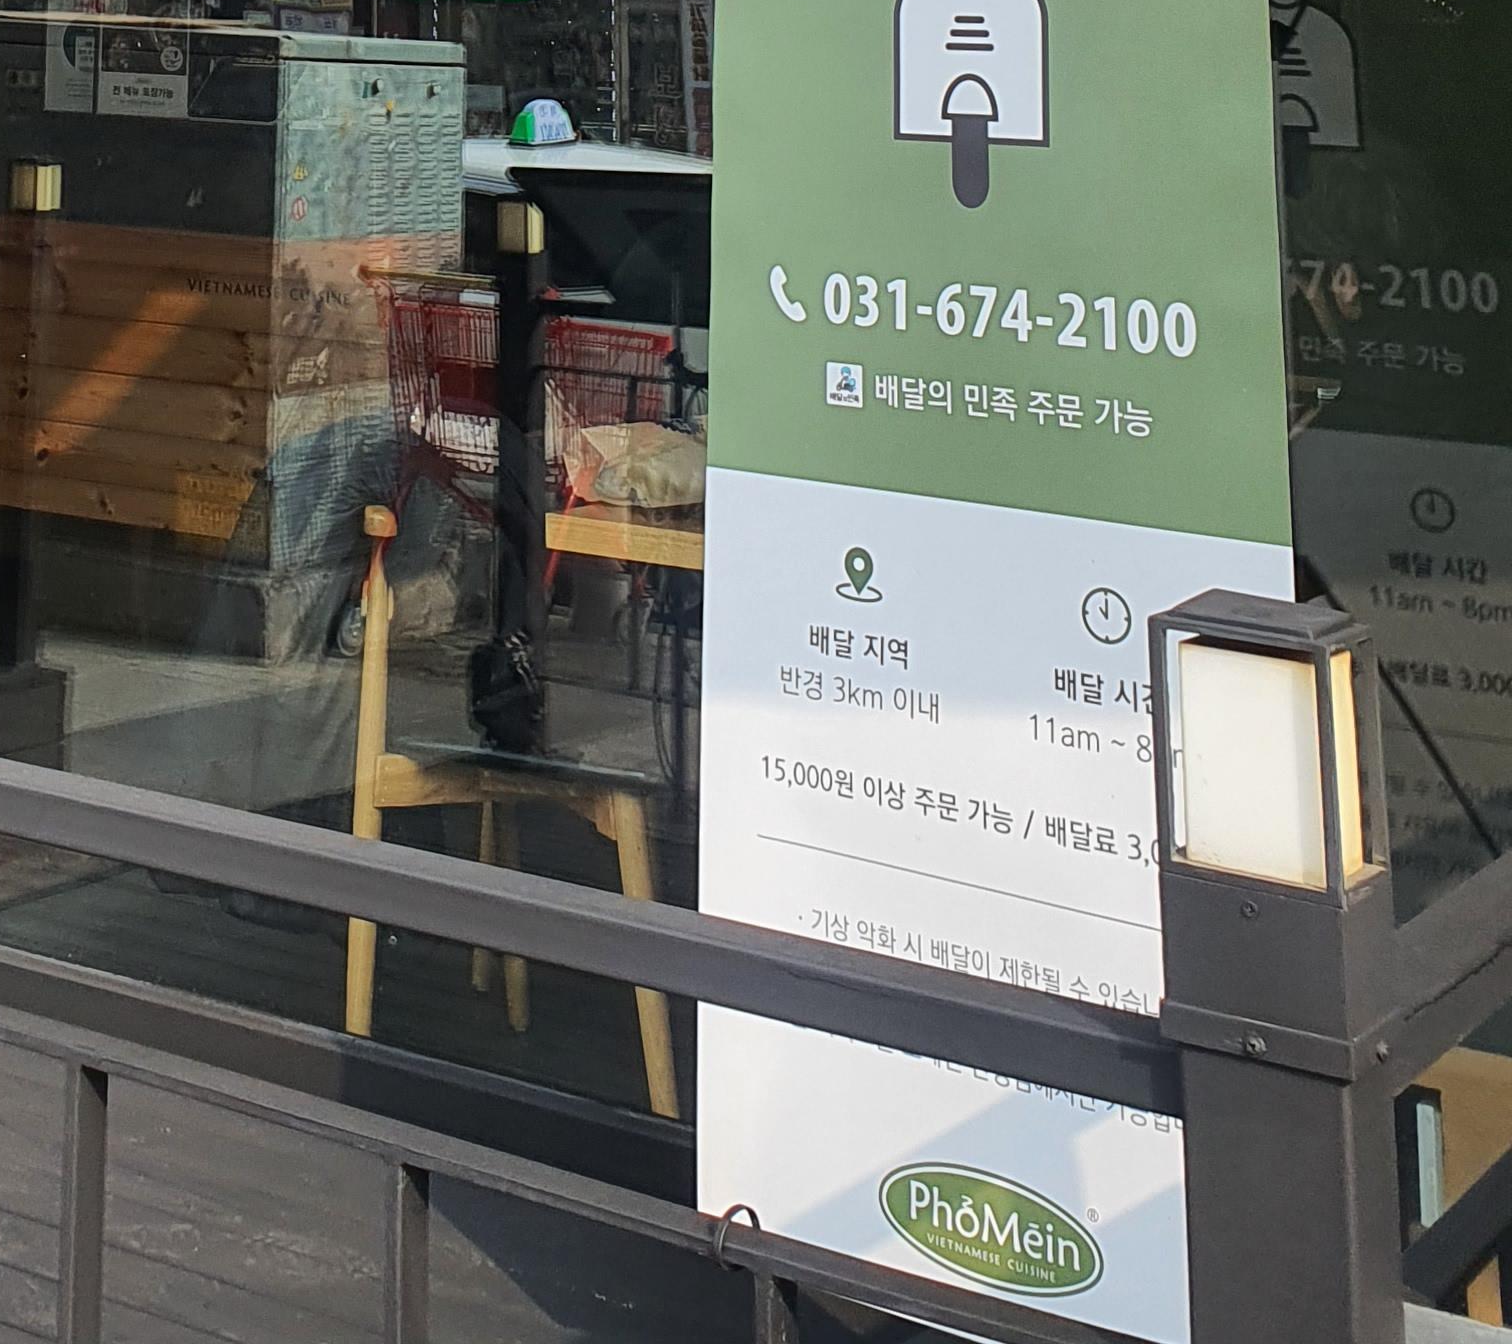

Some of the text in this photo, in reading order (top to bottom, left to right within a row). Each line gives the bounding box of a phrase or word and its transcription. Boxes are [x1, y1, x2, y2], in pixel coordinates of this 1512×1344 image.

[823, 271, 1198, 358] 031-674-2100
[874, 374, 1154, 438] 배달의 민족 주문 가능
[808, 624, 909, 670] 배달 지역
[780, 665, 940, 724] 반경 3km 이내
[1054, 667, 1104, 706] 배달
[1029, 713, 1101, 753] 11am
[761, 755, 855, 800] 15,000원
[863, 776, 906, 811] 이상
[913, 787, 960, 822] 주문
[968, 798, 1015, 835] 가능
[1045, 815, 1119, 855] 배달료
[811, 909, 850, 942] 기상
[855, 921, 897, 953] 악화
[903, 931, 923, 962] 시
[930, 938, 991, 974] 배달이
[999, 955, 1061, 992] 제한될
[926, 1232, 1056, 1284] VIETNAMESE CUISINE
